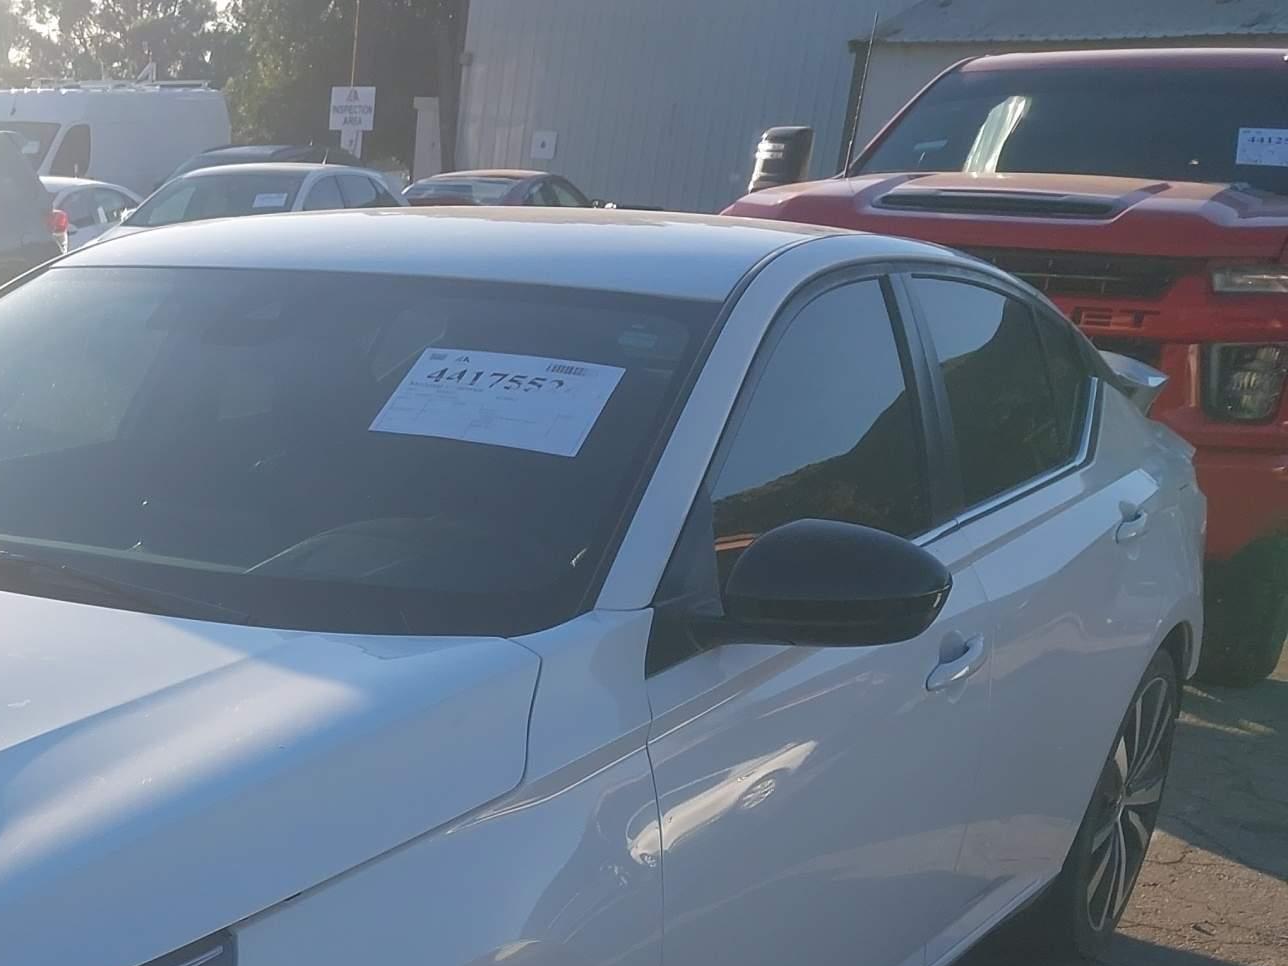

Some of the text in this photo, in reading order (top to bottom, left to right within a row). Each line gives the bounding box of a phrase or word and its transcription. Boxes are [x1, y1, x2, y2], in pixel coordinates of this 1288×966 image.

[333, 104, 373, 114] INSPECTION
[342, 116, 362, 126] AREA
[425, 367, 573, 392] 4417552
